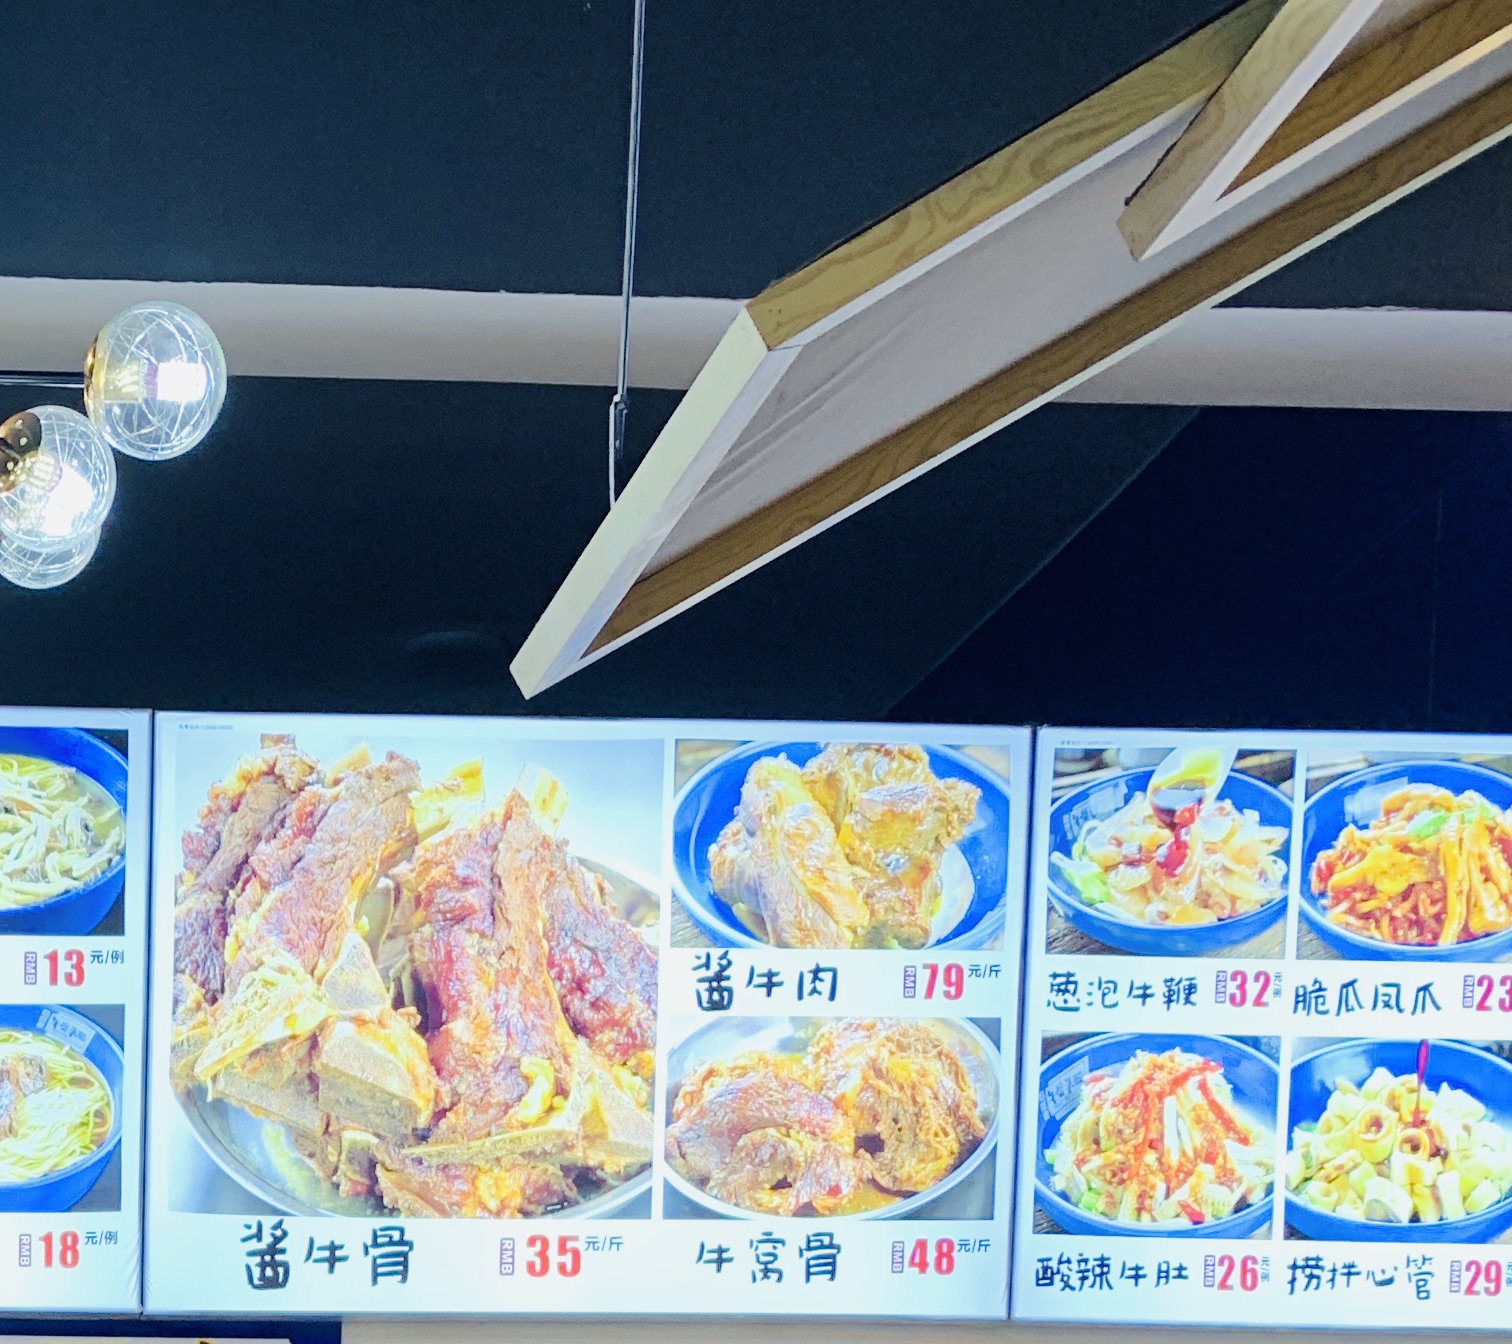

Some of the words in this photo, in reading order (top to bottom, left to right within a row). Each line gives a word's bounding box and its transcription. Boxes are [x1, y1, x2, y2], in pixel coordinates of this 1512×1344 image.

[25, 953, 36, 985] RMB
[44, 950, 84, 986] 13
[90, 950, 124, 964] 元/例
[692, 950, 838, 1011] 酱牛肉
[905, 967, 916, 998] RMB
[923, 964, 963, 1000] 79
[969, 964, 1001, 978] 元/斤
[1217, 972, 1226, 1003] RMB
[1229, 971, 1270, 1007] 32
[1293, 978, 1441, 1016] 脆瓜凤爪
[1464, 976, 1473, 1008] RMB
[1477, 974, 1512, 1012] 23
[20, 1235, 31, 1267] RMB
[41, 1232, 79, 1268] 18
[85, 1231, 117, 1245] 元/例
[240, 1219, 414, 1290] 酱牛骨
[501, 1239, 513, 1275] RMB
[527, 1235, 581, 1277] 35
[585, 1236, 623, 1251] 元/斤
[696, 1232, 841, 1283] 牛窝骨
[893, 1242, 904, 1273] RMB
[909, 1239, 954, 1274] 48
[958, 1239, 990, 1253] 元/斤
[1035, 1252, 1188, 1292] 酸辣牛肚
[1205, 1256, 1215, 1287] RMB
[1218, 1255, 1258, 1291] 26
[1288, 1255, 1434, 1300] 捞拌心管
[1451, 1262, 1460, 1292] RMB
[1465, 1260, 1502, 1296] 29
